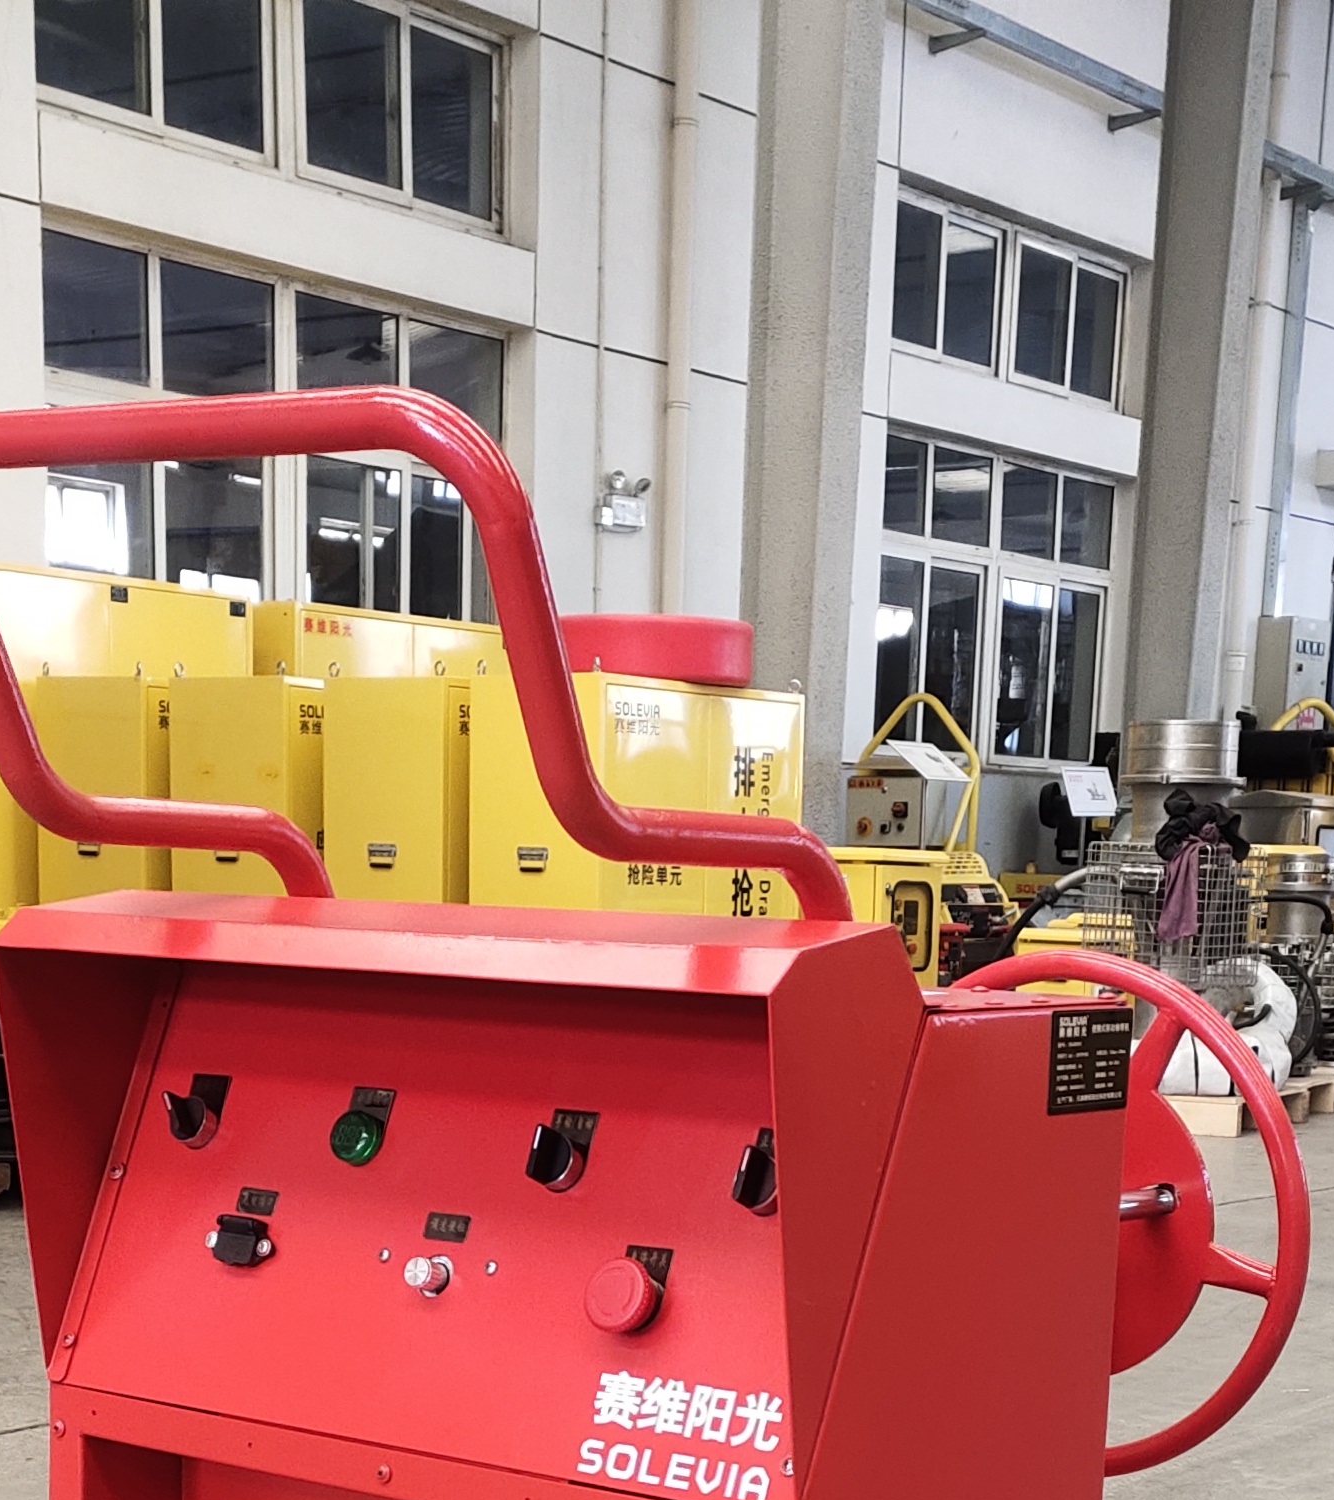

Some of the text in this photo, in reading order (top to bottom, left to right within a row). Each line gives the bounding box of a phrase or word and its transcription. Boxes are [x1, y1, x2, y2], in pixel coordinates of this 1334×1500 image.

[303, 616, 353, 637] 赛维阳光
[299, 704, 324, 719] SOL
[614, 701, 661, 719] SOLEVIA
[614, 718, 661, 736] 赛维阳光
[627, 864, 683, 886] 抢险单元
[593, 1370, 783, 1452] 赛维阳光
